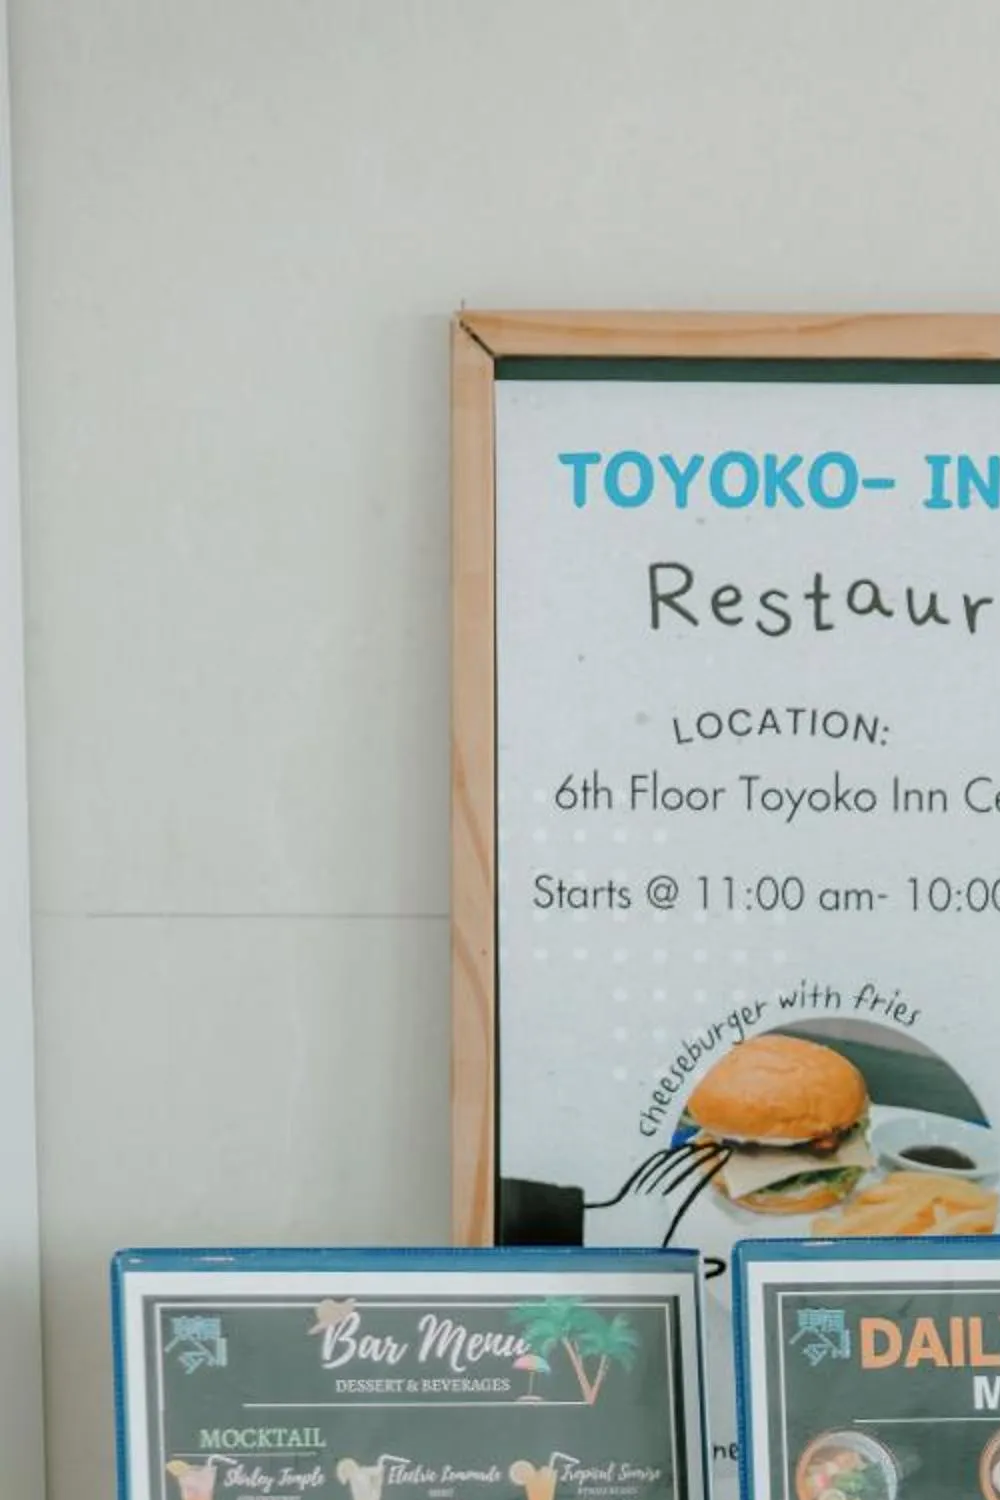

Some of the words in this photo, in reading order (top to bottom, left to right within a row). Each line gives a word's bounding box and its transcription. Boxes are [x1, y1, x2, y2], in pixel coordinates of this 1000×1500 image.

[557, 449, 897, 511] TOYOKO-
[672, 707, 891, 748] LOCATION:
[554, 769, 613, 811] 6th
[630, 769, 726, 812] Floor
[738, 770, 878, 825] Toyoko
[893, 775, 949, 814] Inn
[533, 873, 632, 911] Starts
[645, 874, 680, 912] @
[697, 874, 806, 912] 11:00
[818, 888, 888, 913] am-
[639, 1000, 769, 1138] cheeseburger
[779, 979, 842, 1010] with
[854, 984, 922, 1027] fries
[321, 1311, 409, 1370] Bar
[418, 1313, 532, 1372] Menu
[335, 1379, 405, 1394] DESSERT
[406, 1378, 419, 1392] &
[421, 1377, 512, 1393] BEVERAGES
[200, 1427, 327, 1450] MOCKTAIL
